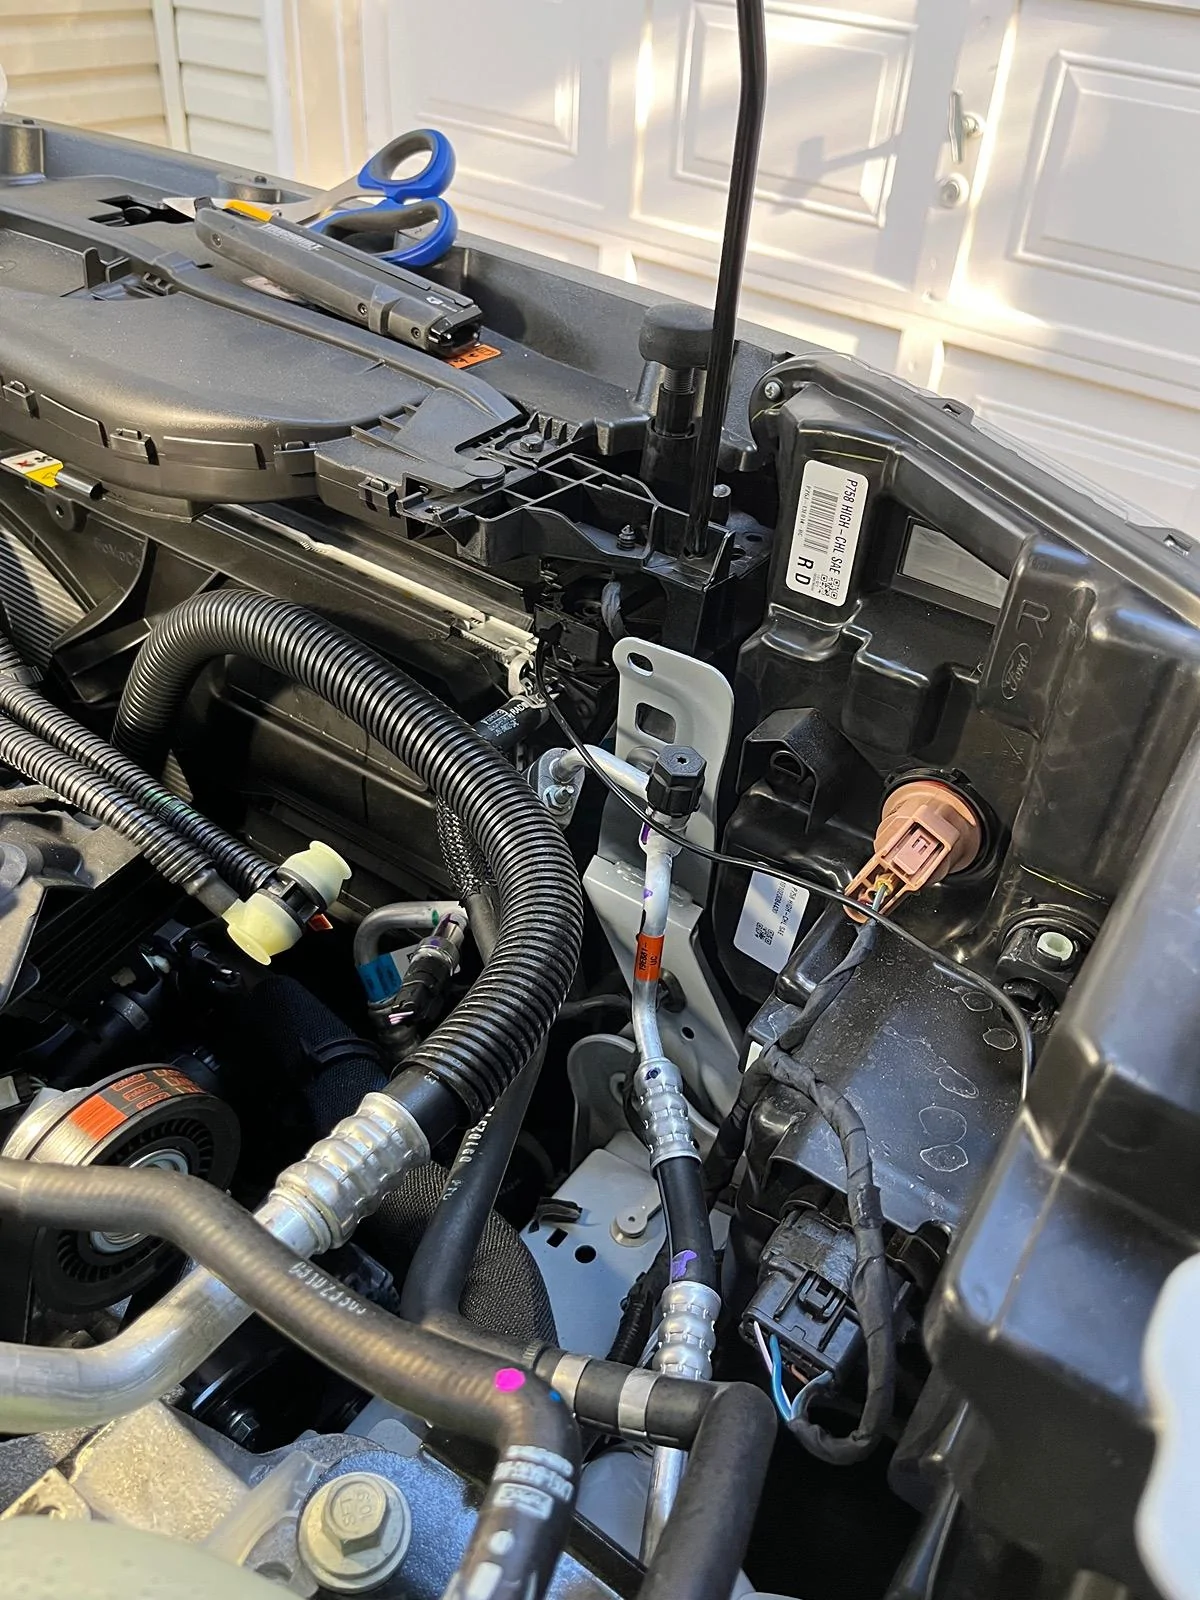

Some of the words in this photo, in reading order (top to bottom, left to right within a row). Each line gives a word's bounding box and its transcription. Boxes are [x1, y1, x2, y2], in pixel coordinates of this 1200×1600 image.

[842, 478, 859, 503] P758
[829, 556, 843, 575] SAE
[1015, 599, 1051, 638] R
[1005, 651, 1029, 692] Ford
